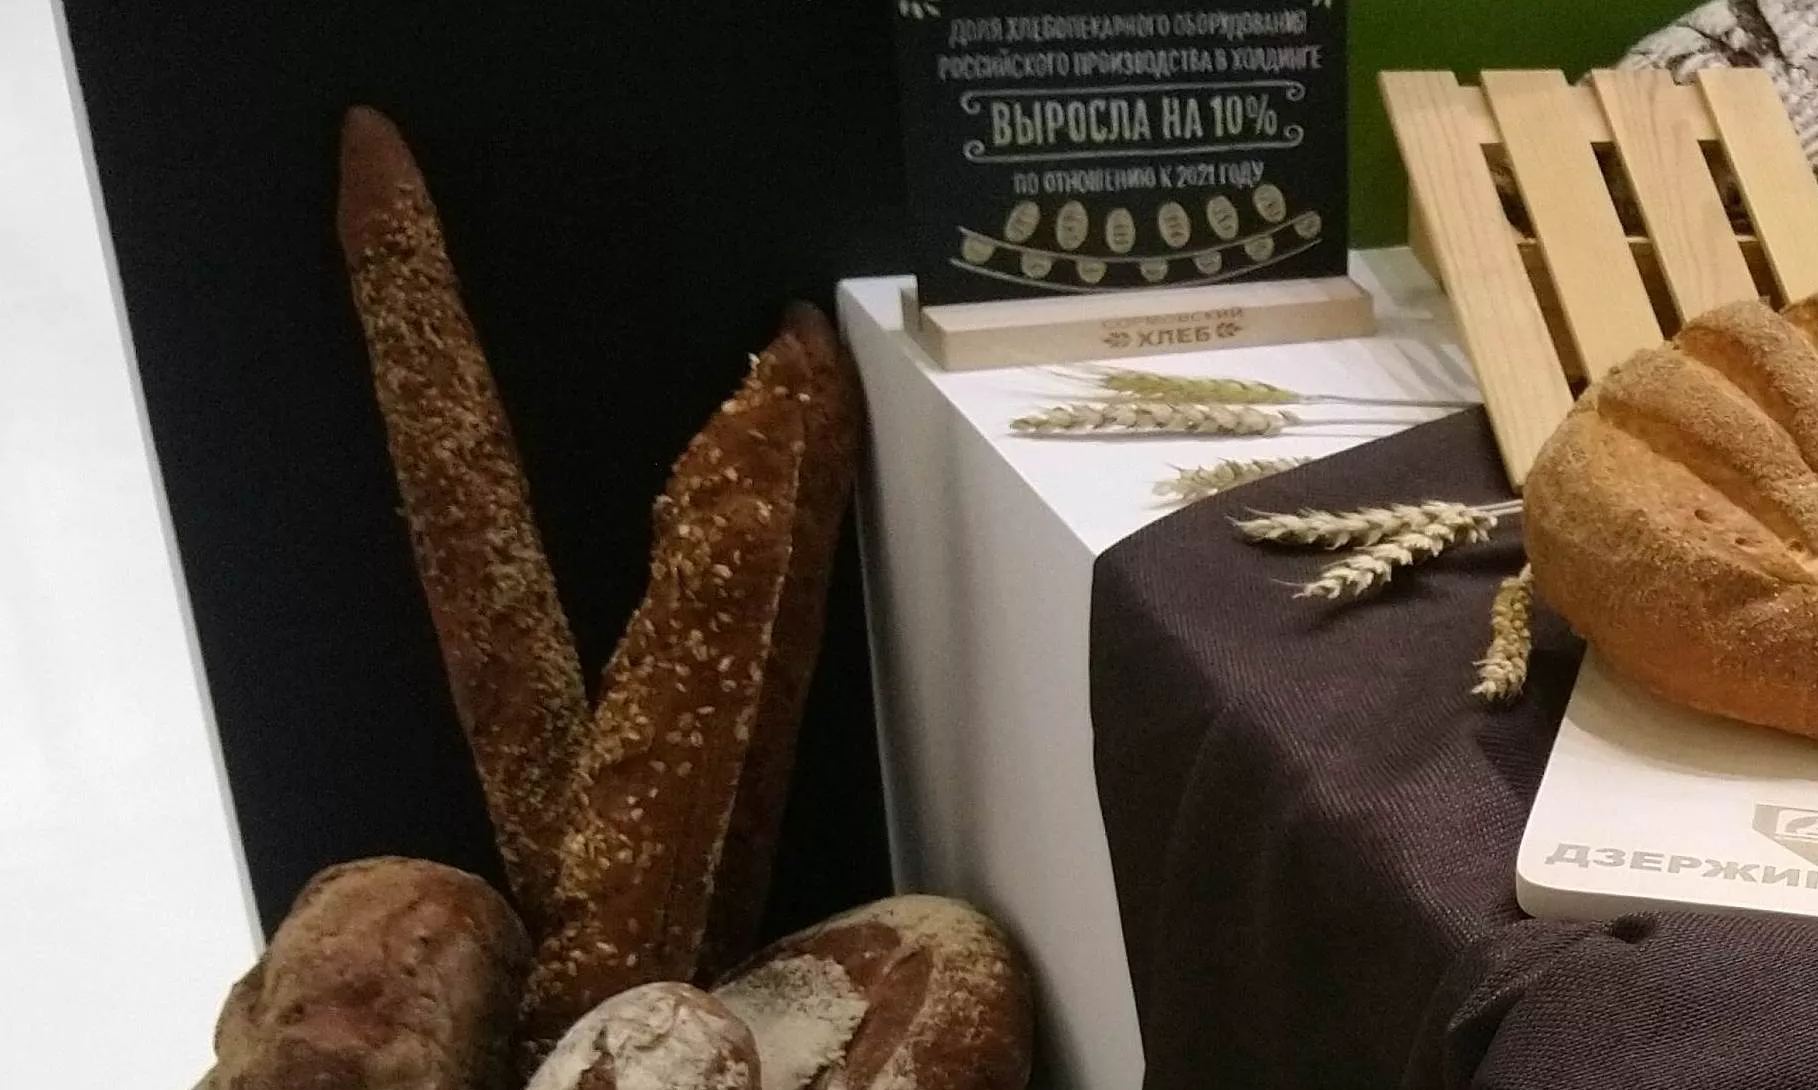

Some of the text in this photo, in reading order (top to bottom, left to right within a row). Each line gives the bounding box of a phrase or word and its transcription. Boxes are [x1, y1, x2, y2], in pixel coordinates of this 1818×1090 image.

[1005, 13, 1170, 42] ХЛЕБОПЕКАРНОГО
[937, 44, 1323, 80] РОССИЙСКОГО ПРОИЗВОДСТВА В ХОЛДИНГЕ
[991, 93, 1279, 146] ВЫРОСЛА НА 10%
[1013, 159, 1265, 196] ПО ОТНОШЕНИЮ К 2021 ГОДУ
[1136, 326, 1212, 348] ХЛЕБ
